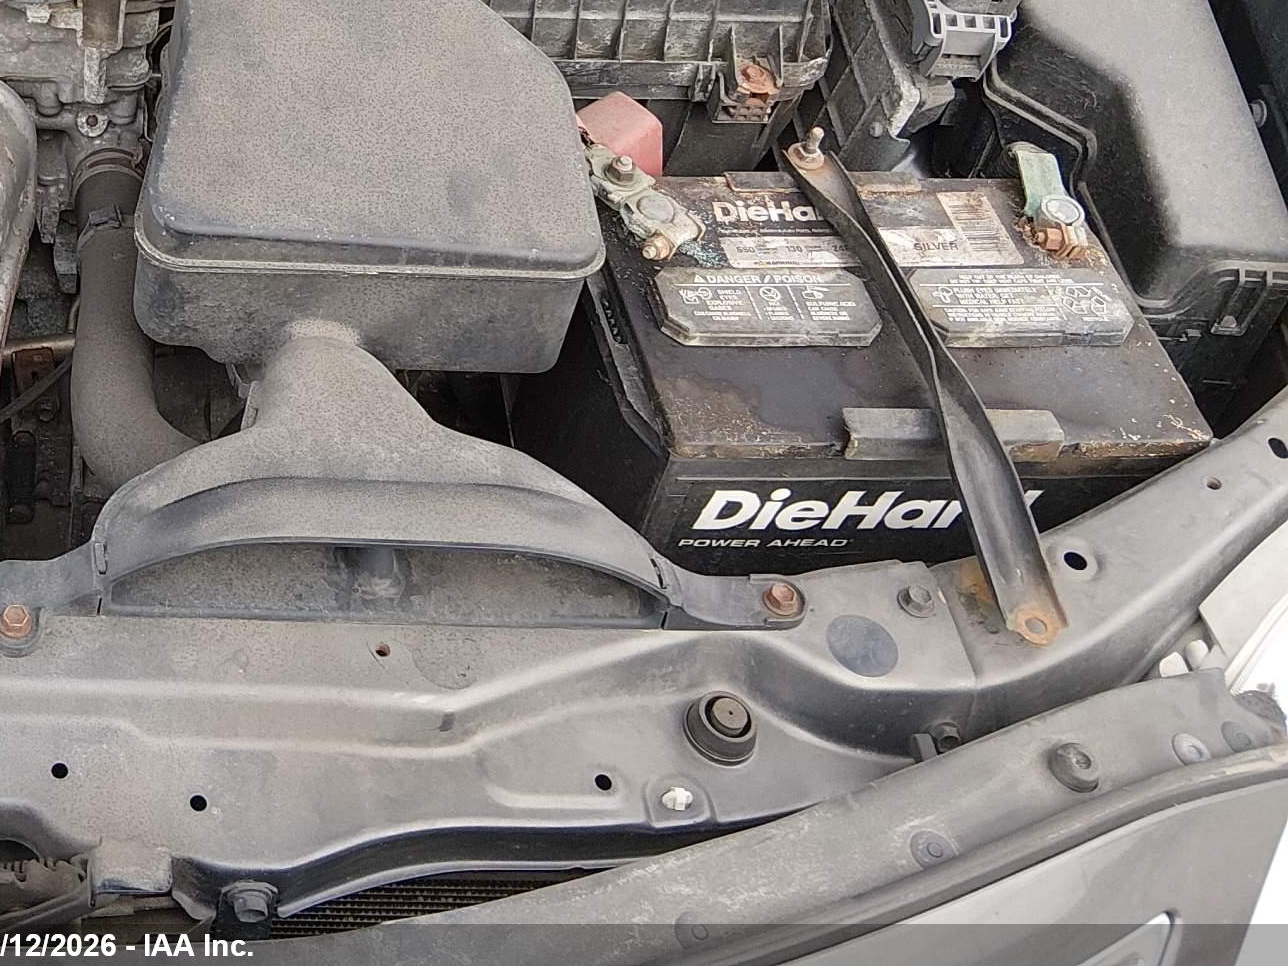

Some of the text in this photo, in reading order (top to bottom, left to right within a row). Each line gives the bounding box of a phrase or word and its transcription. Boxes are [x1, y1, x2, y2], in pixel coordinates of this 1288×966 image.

[712, 200, 825, 222] DieHa
[913, 241, 959, 252] SILVER
[706, 274, 762, 284] DANGER
[772, 274, 824, 284] POISON
[691, 487, 1045, 531] DieHar
[678, 538, 849, 548] POWER AHEAD
